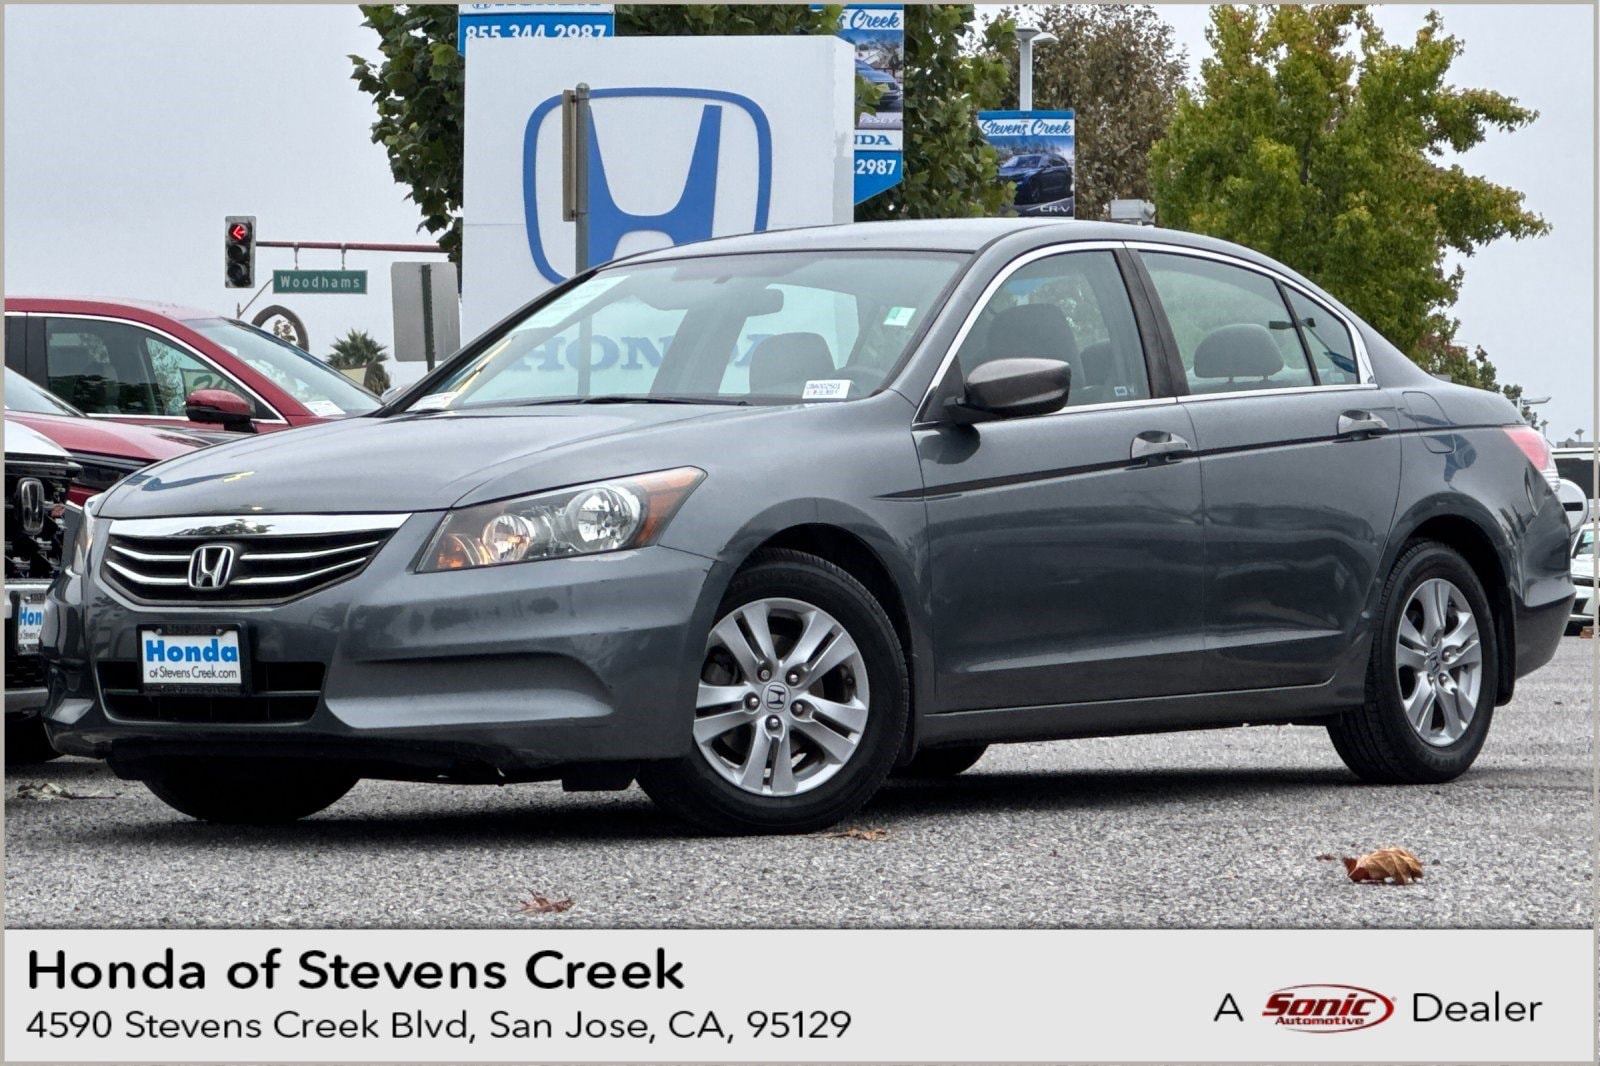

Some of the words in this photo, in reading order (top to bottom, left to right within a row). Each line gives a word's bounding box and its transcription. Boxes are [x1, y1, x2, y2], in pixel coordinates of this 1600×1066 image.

[851, 8, 900, 29] Creek
[982, 120, 1028, 136] Stevens
[1031, 119, 1071, 136] Creek
[280, 275, 360, 288] Woodhams
[19, 607, 43, 626] Hon
[146, 639, 238, 662] Honda
[149, 668, 158, 678] of
[159, 666, 190, 678] Stevens
[191, 665, 237, 678] Creek.com
